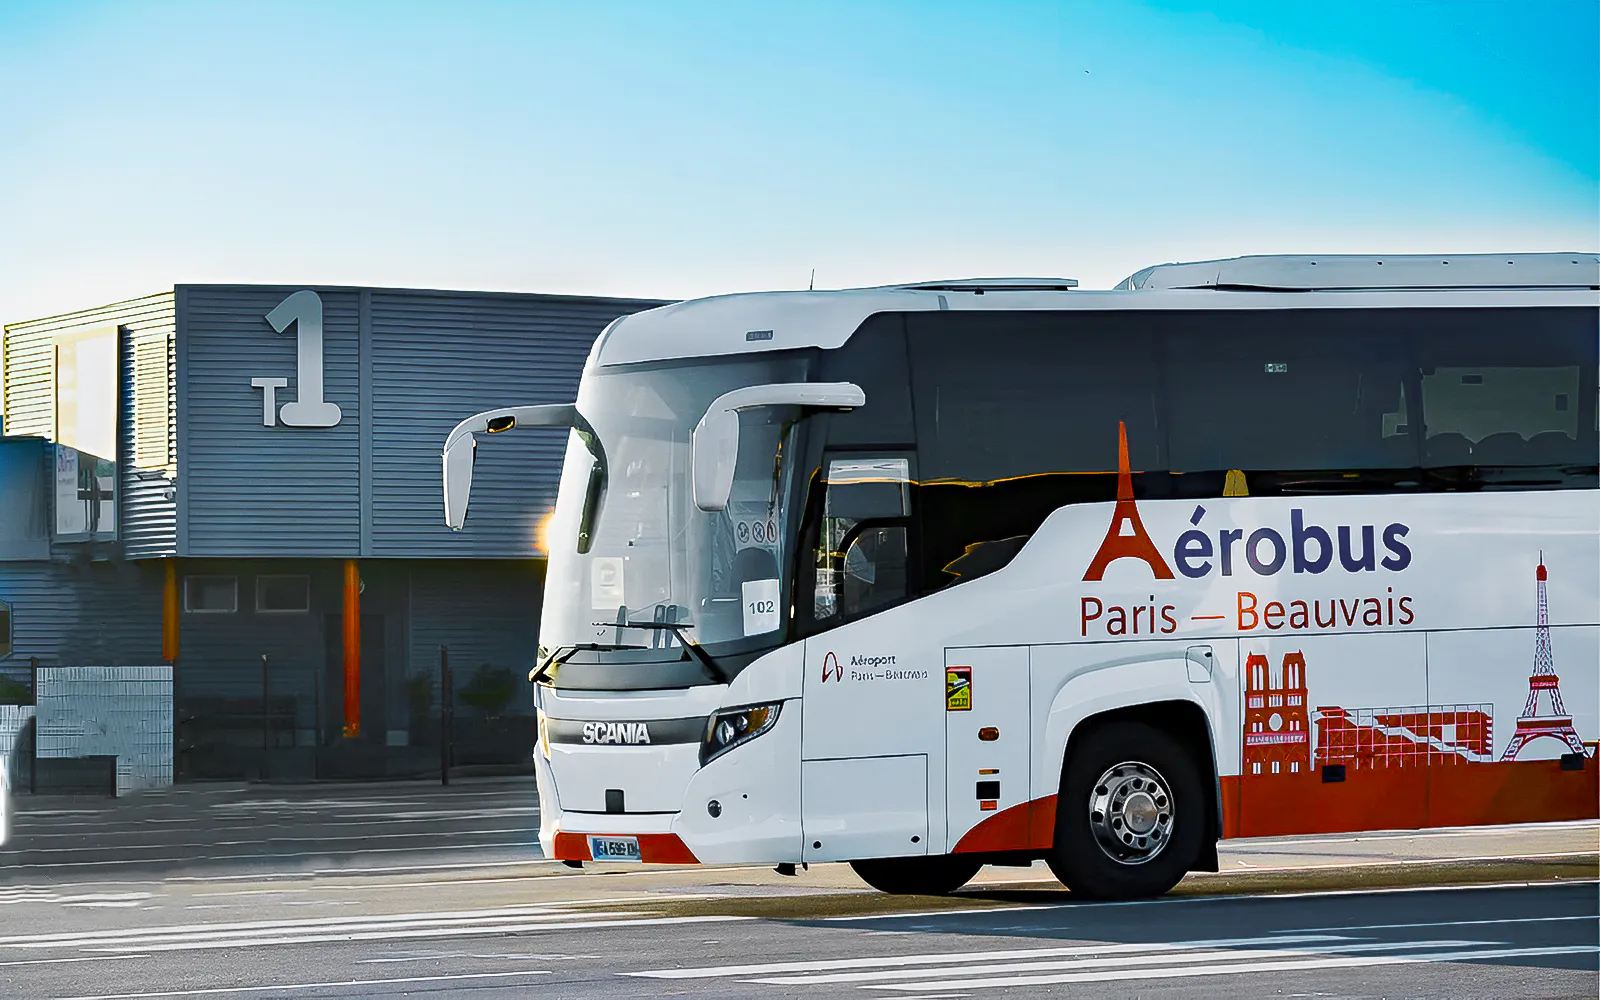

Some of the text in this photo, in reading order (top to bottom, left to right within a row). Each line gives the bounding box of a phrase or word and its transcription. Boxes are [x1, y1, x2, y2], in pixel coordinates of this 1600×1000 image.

[1081, 420, 1412, 581] Aérobus
[748, 601, 775, 614] 102
[1080, 594, 1177, 636] Paris
[1236, 587, 1415, 631] Beauvais
[582, 722, 651, 744] SCANIA
